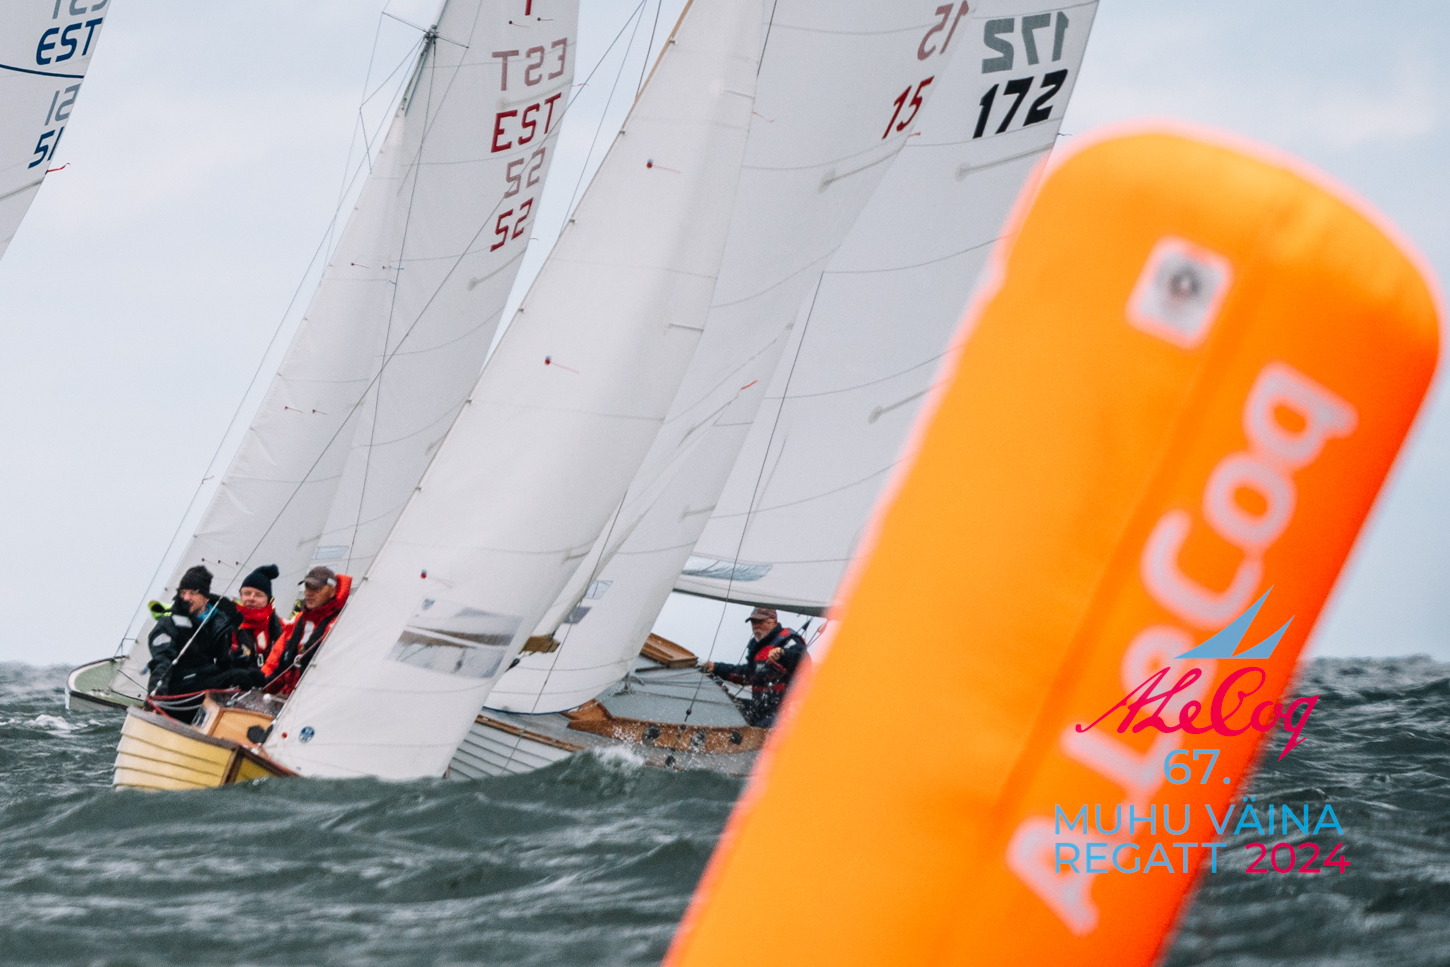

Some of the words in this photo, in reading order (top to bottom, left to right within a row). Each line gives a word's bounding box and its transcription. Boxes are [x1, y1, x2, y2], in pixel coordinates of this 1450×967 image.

[36, 17, 104, 65] EST
[490, 92, 562, 153] EST
[882, 75, 935, 139] 15
[972, 68, 1068, 139] 172
[28, 126, 65, 169] 51
[489, 197, 534, 252] 52
